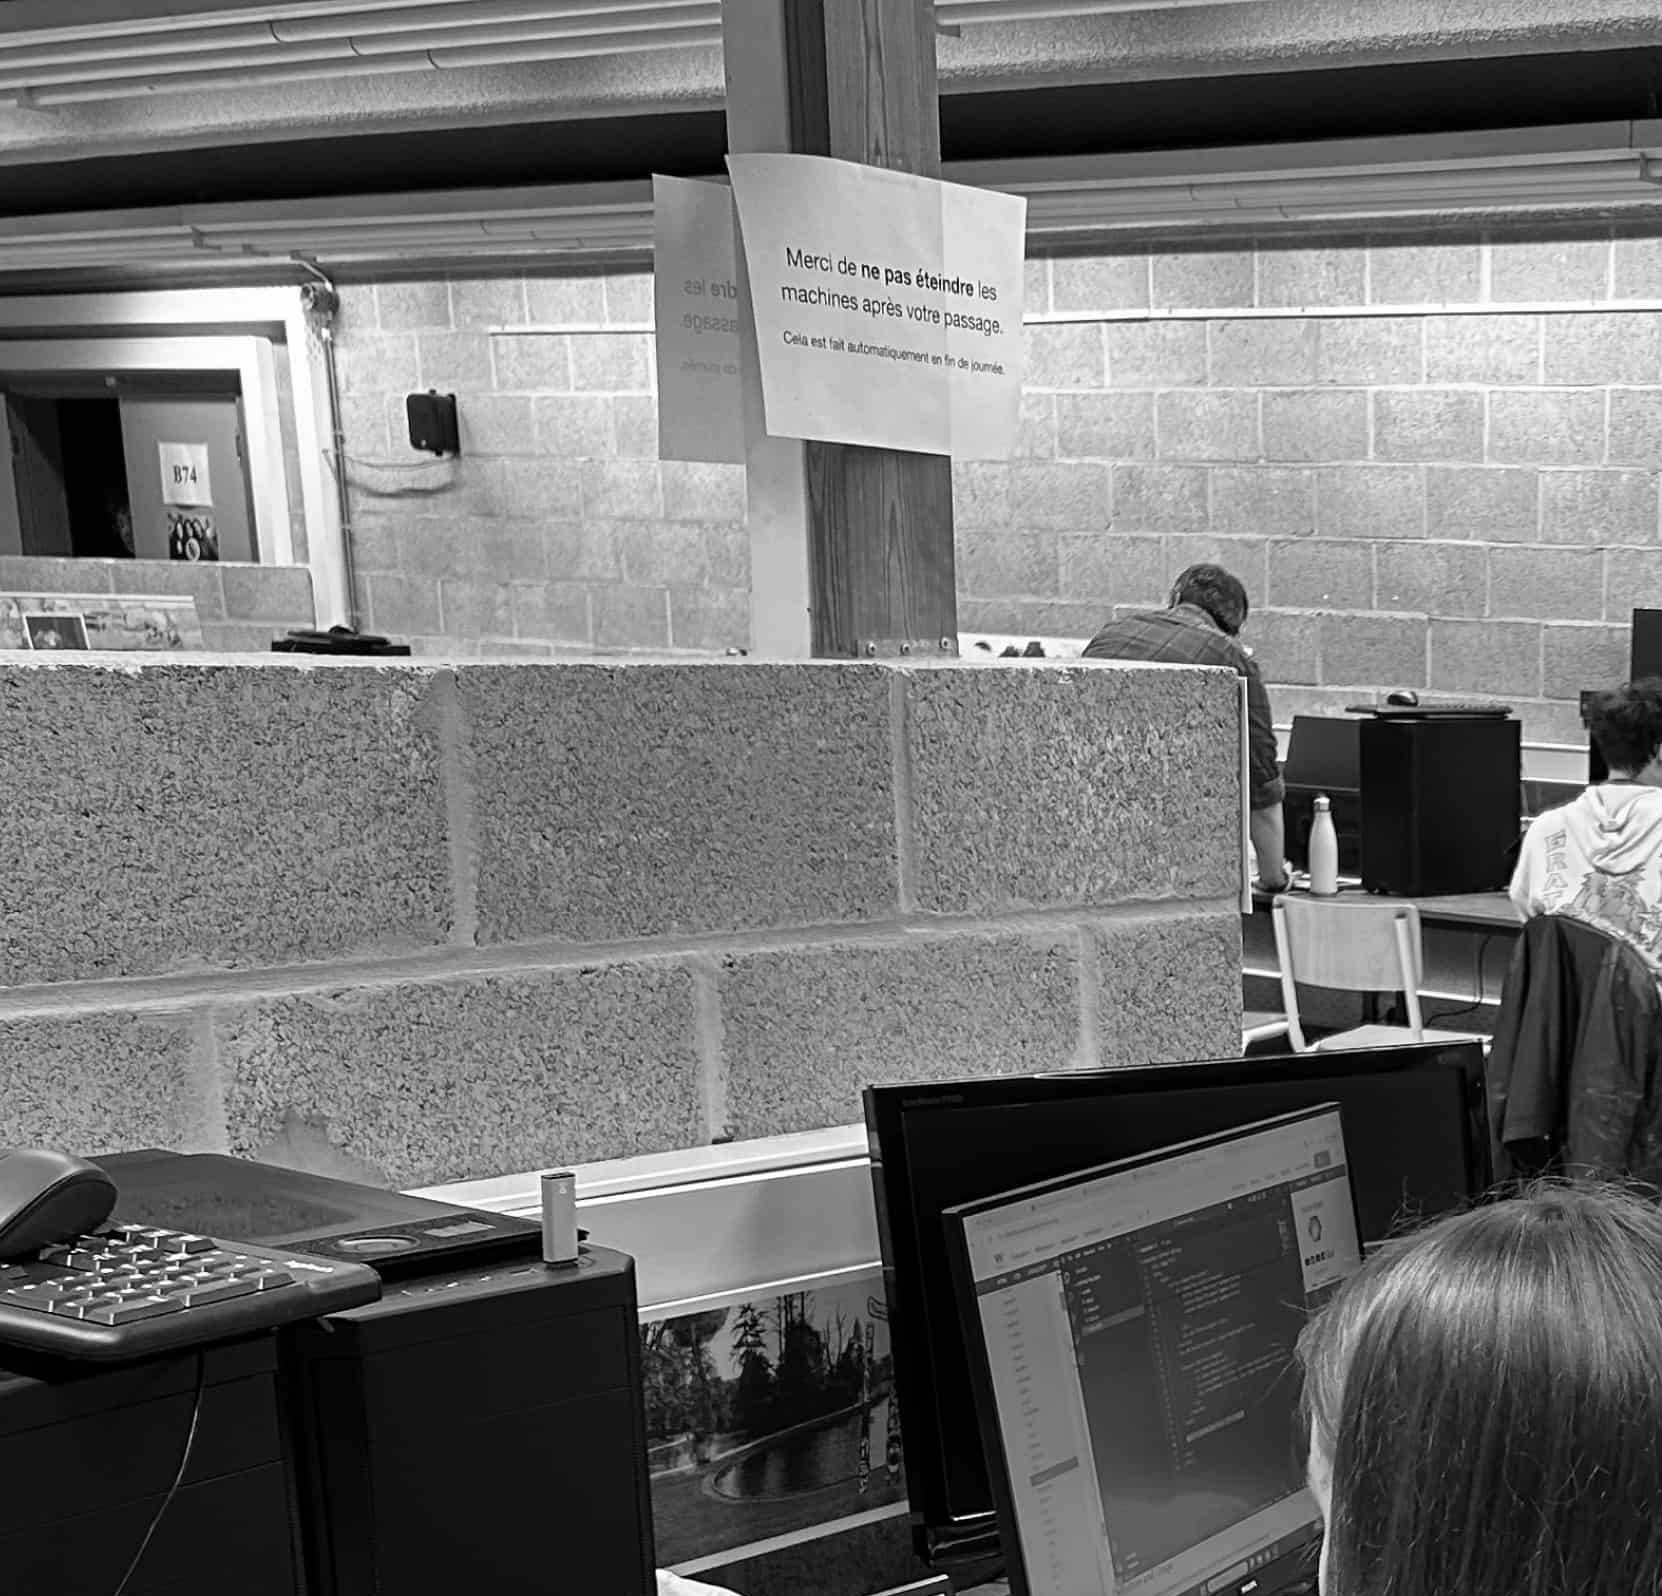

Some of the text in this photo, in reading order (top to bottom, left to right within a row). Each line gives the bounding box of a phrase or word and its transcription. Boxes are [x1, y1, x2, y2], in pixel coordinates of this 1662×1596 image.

[786, 247, 997, 301] Merci de ne pas éteindre les
[781, 285, 1004, 337] machines après votre passage.
[783, 330, 808, 346] Cela
[811, 336, 827, 349] est
[829, 337, 845, 352] fait
[847, 341, 929, 364] automatiquement
[931, 355, 942, 365] en
[944, 353, 956, 367] fin
[957, 356, 969, 370] de
[173, 465, 197, 484] B74
